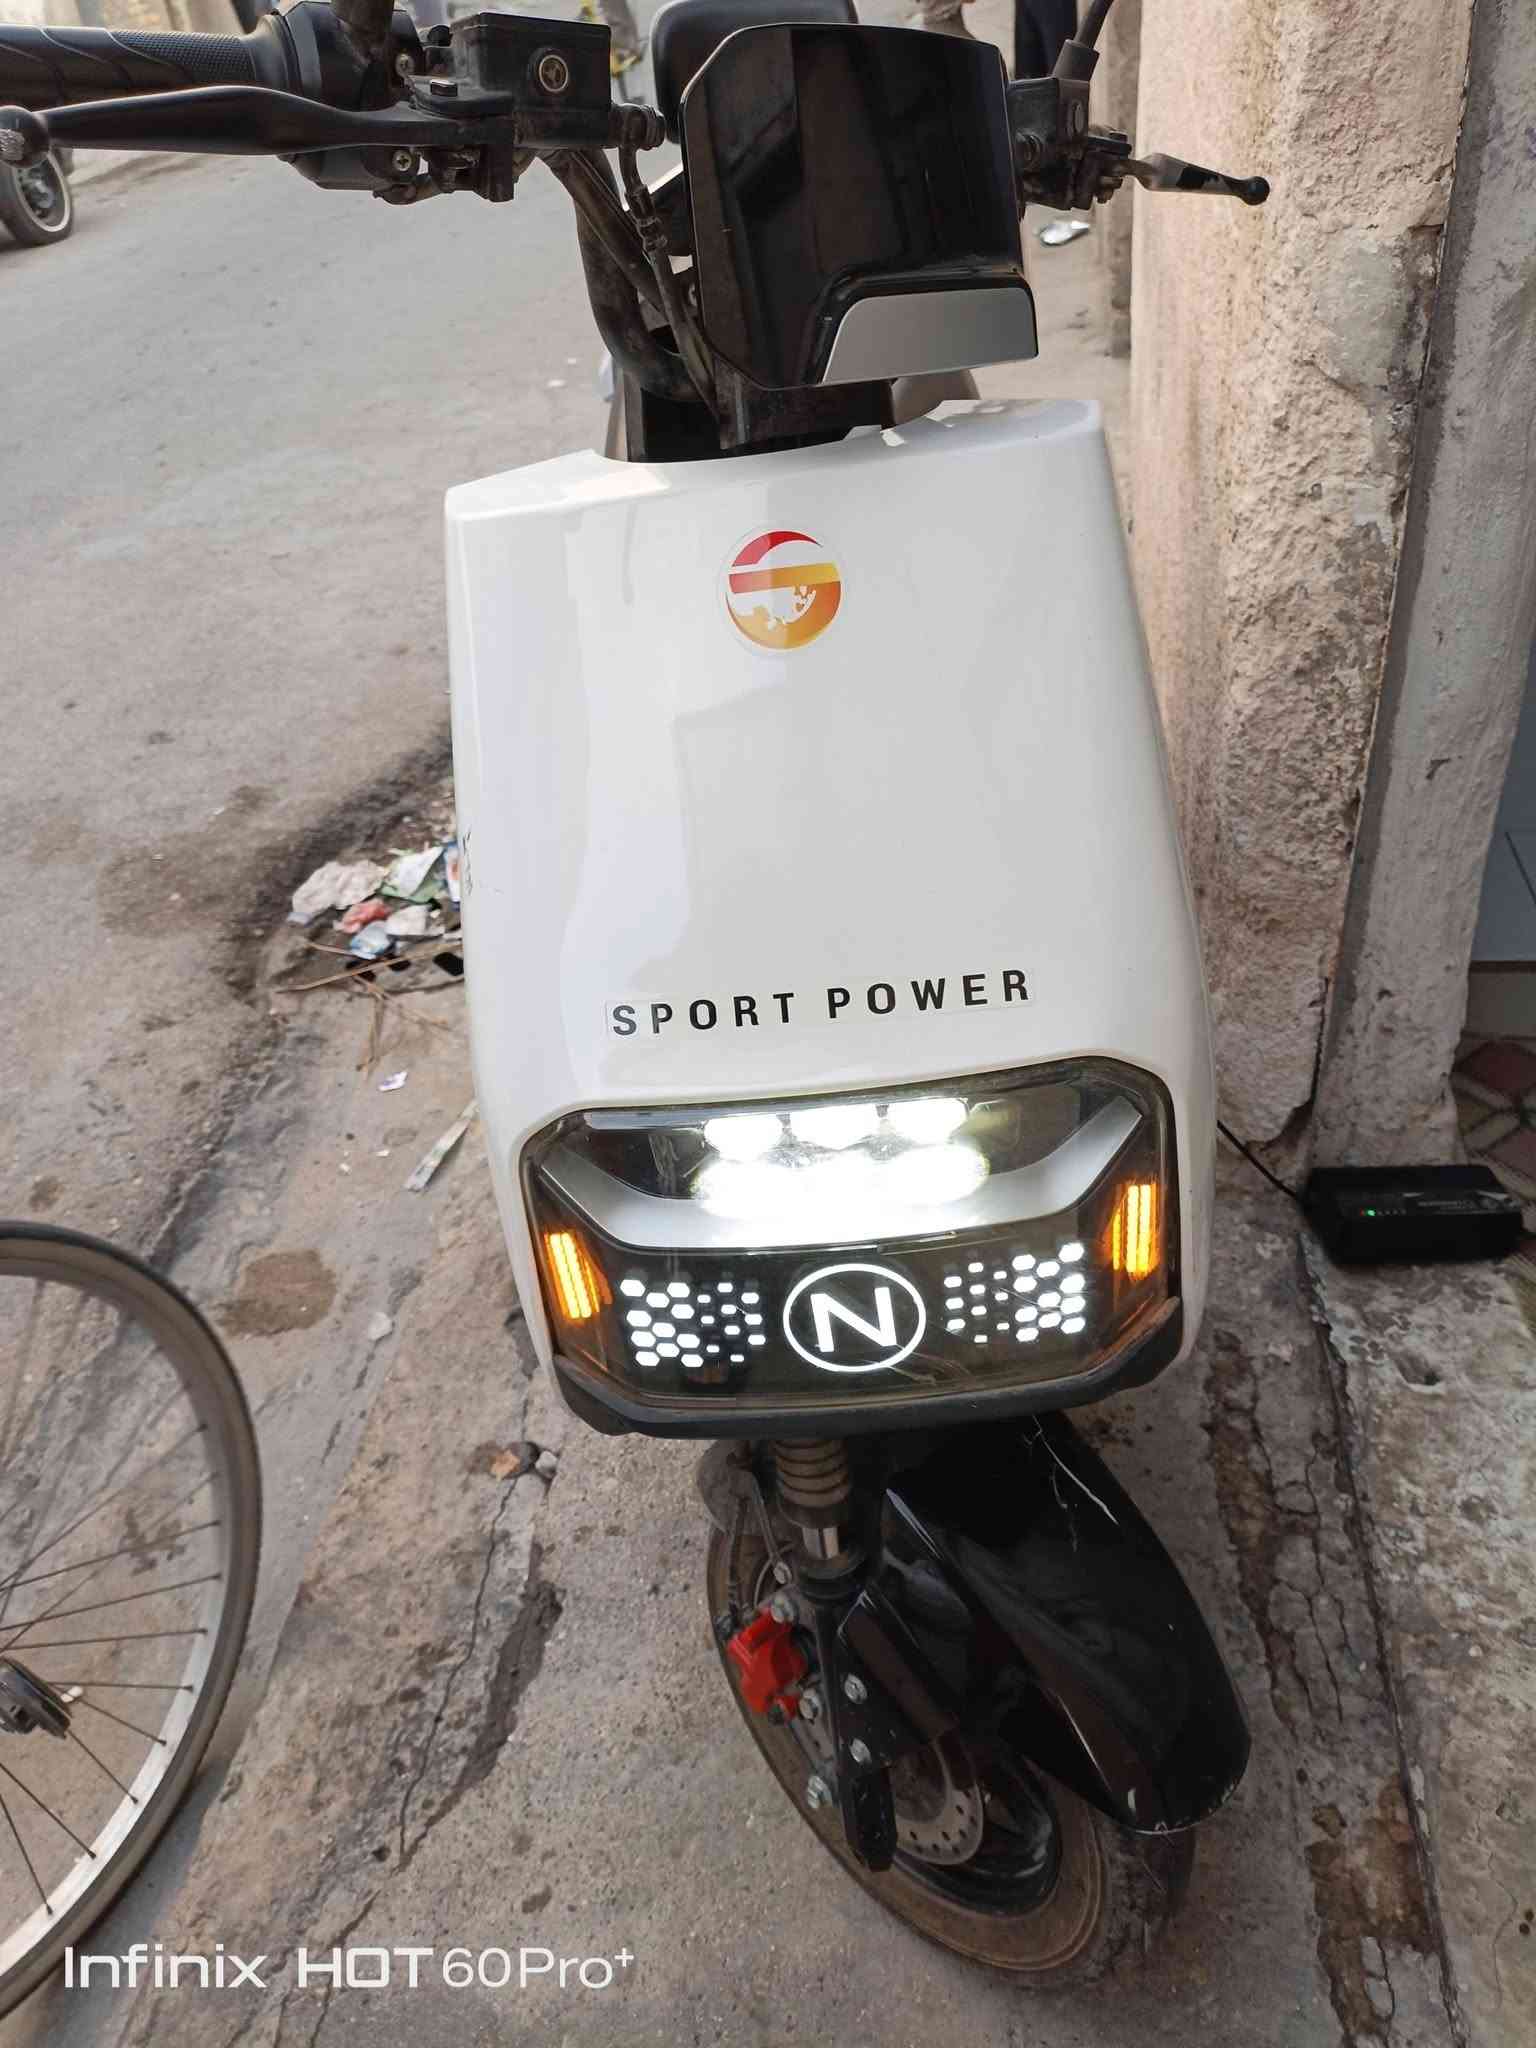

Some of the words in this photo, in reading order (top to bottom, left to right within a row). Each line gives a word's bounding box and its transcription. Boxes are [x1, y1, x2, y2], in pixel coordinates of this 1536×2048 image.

[612, 992, 795, 1036] SPORT
[826, 969, 1029, 1020] POWER
[810, 1286, 898, 1353] N
